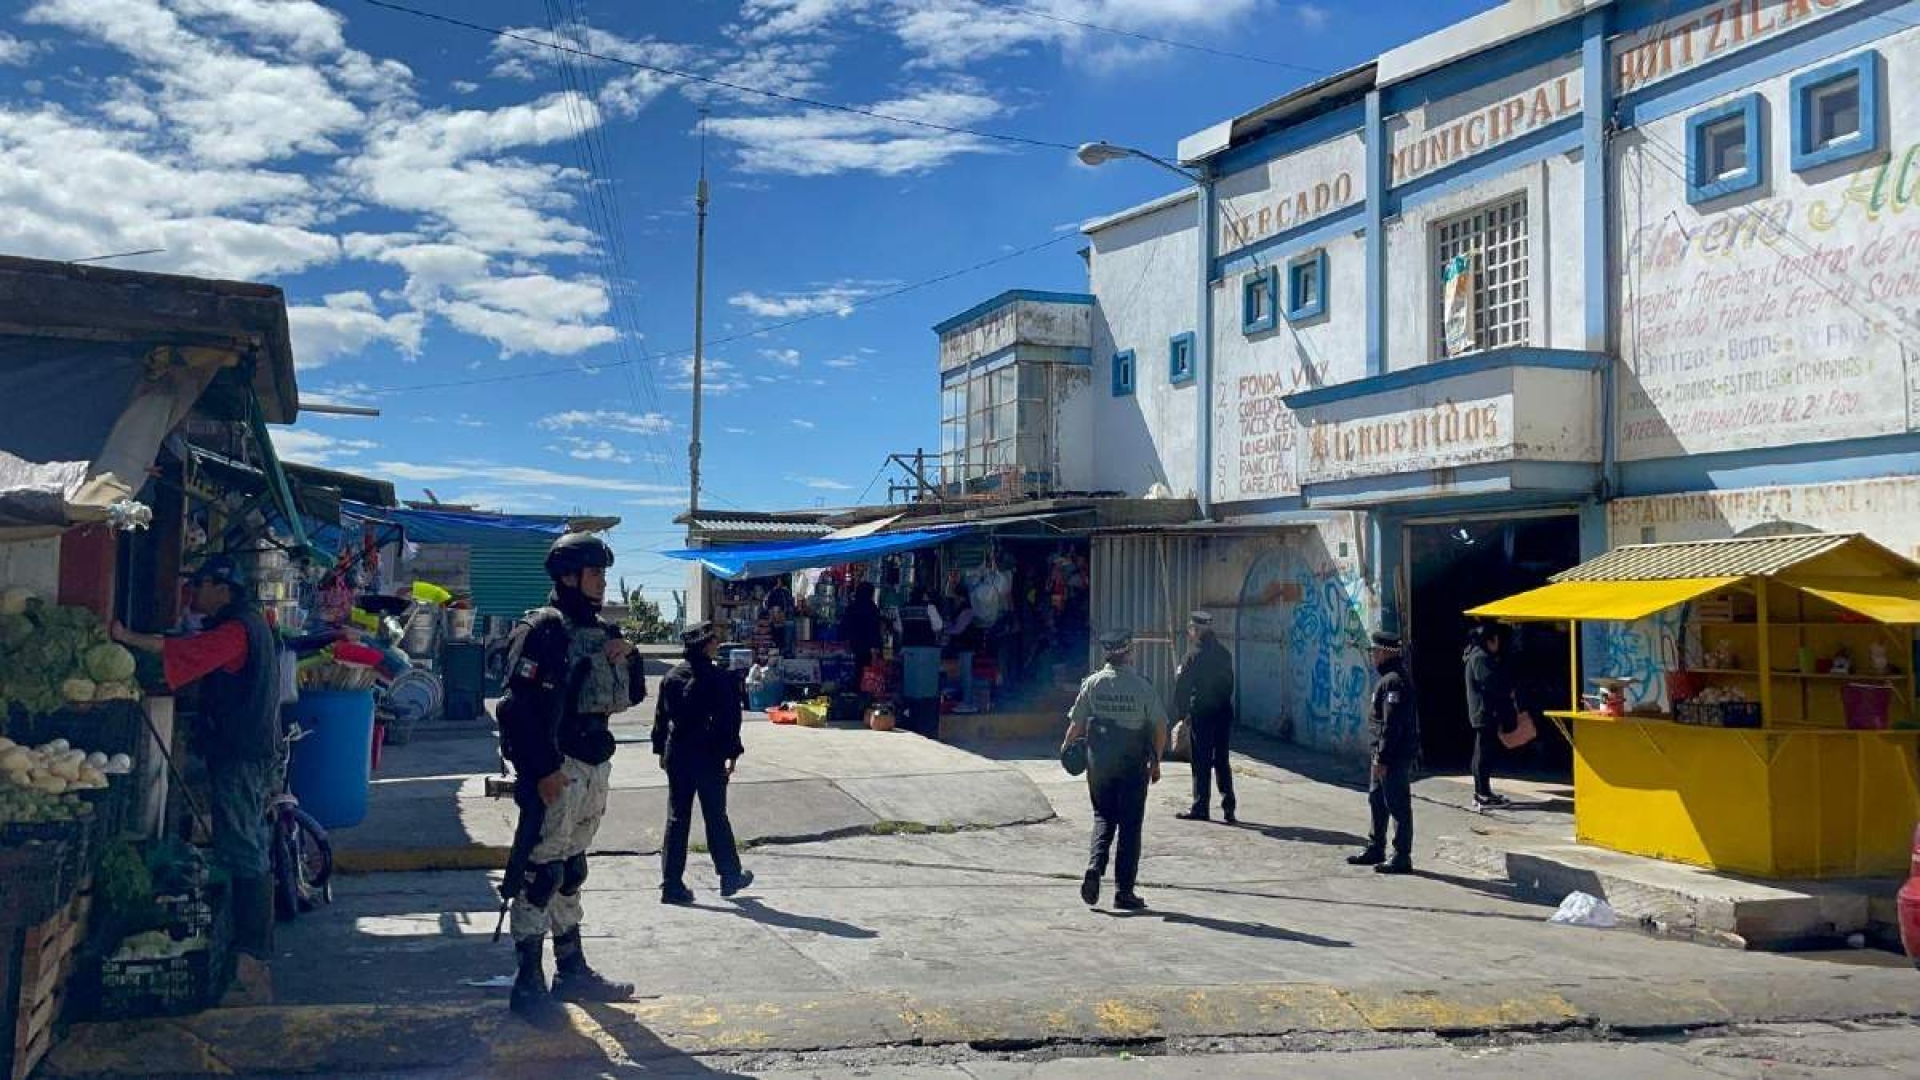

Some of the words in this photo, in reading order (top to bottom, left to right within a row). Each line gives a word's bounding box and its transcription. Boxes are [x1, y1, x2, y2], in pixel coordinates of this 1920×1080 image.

[1223, 172, 1352, 250] MERCADO
[1390, 77, 1580, 184] MUNICIPAL
[1861, 226, 1897, 269] de
[1239, 371, 1283, 400] FONDA
